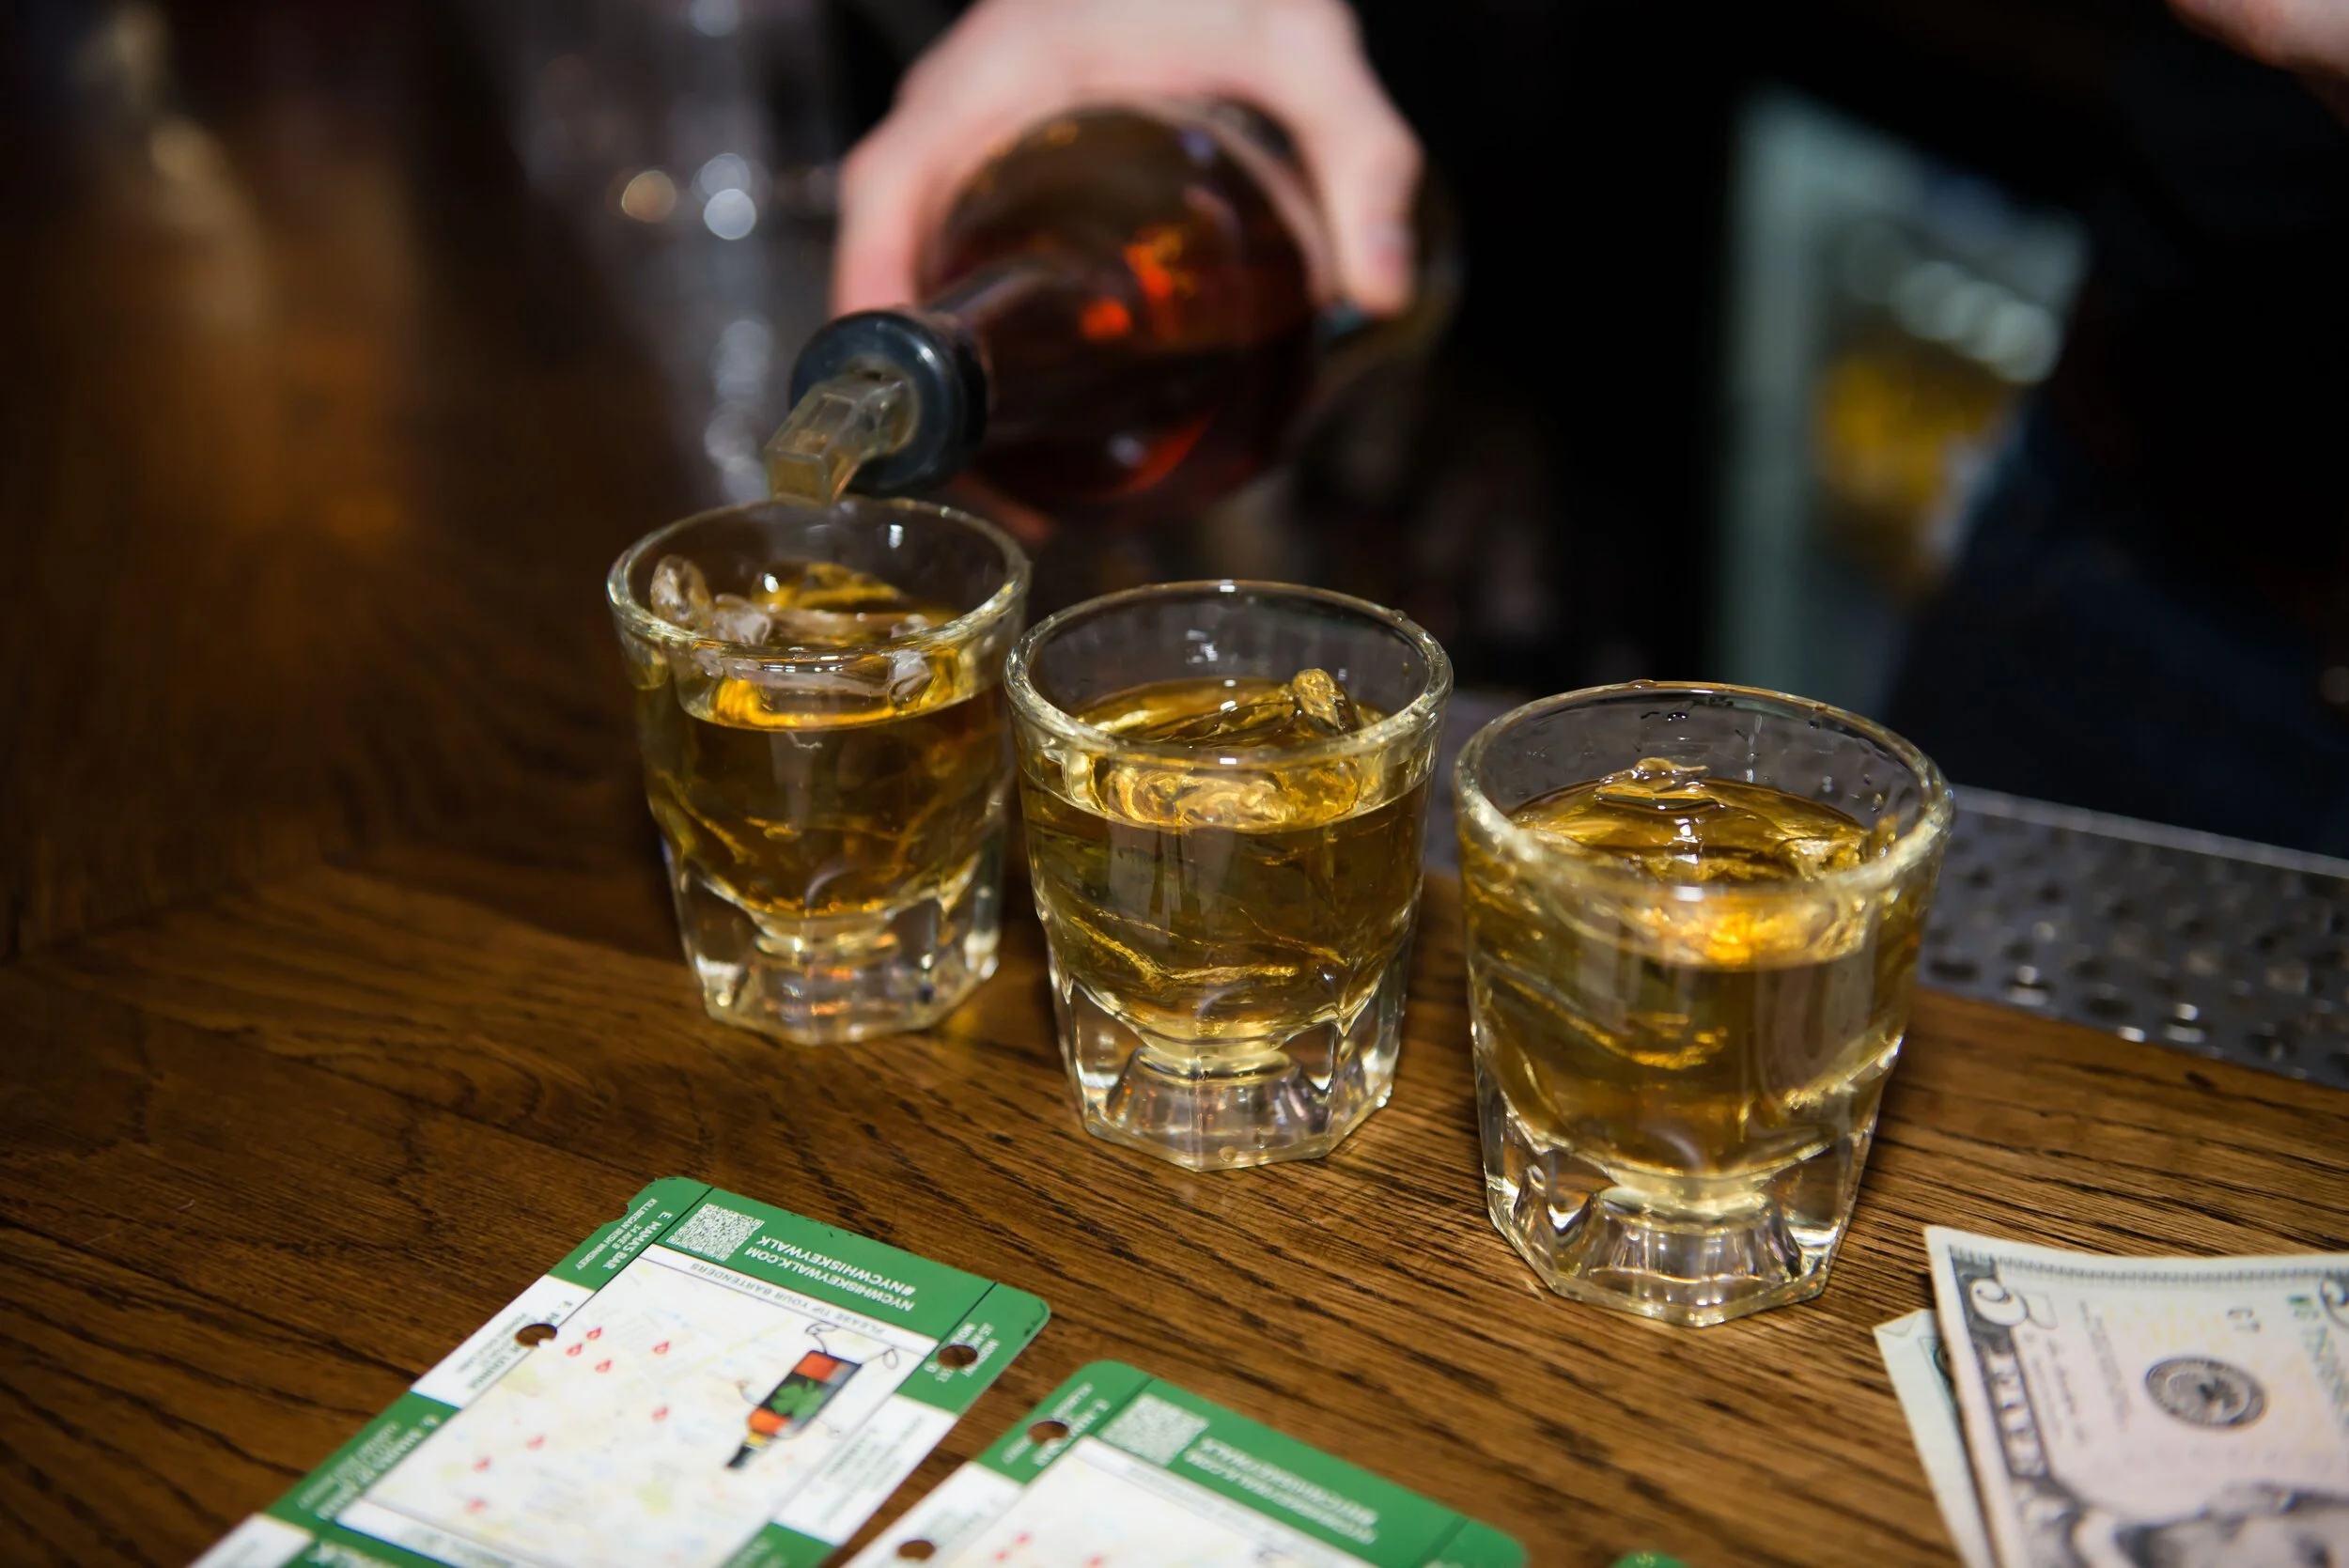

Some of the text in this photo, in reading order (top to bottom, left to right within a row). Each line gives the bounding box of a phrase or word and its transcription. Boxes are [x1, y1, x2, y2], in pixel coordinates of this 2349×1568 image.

[603, 1227, 625, 1245] IRISH
[616, 1232, 632, 1246] AVE
[622, 1220, 662, 1252] MAMA'S
[576, 1243, 609, 1270] WHISKEY
[602, 1251, 628, 1269] BAR
[755, 1234, 916, 1296] #NYCWHISKEYWALK
[690, 1262, 774, 1296] BARTENDERS
[743, 1246, 916, 1312] NYCWHISKEYWALK.COM
[773, 1291, 808, 1311] YOUR
